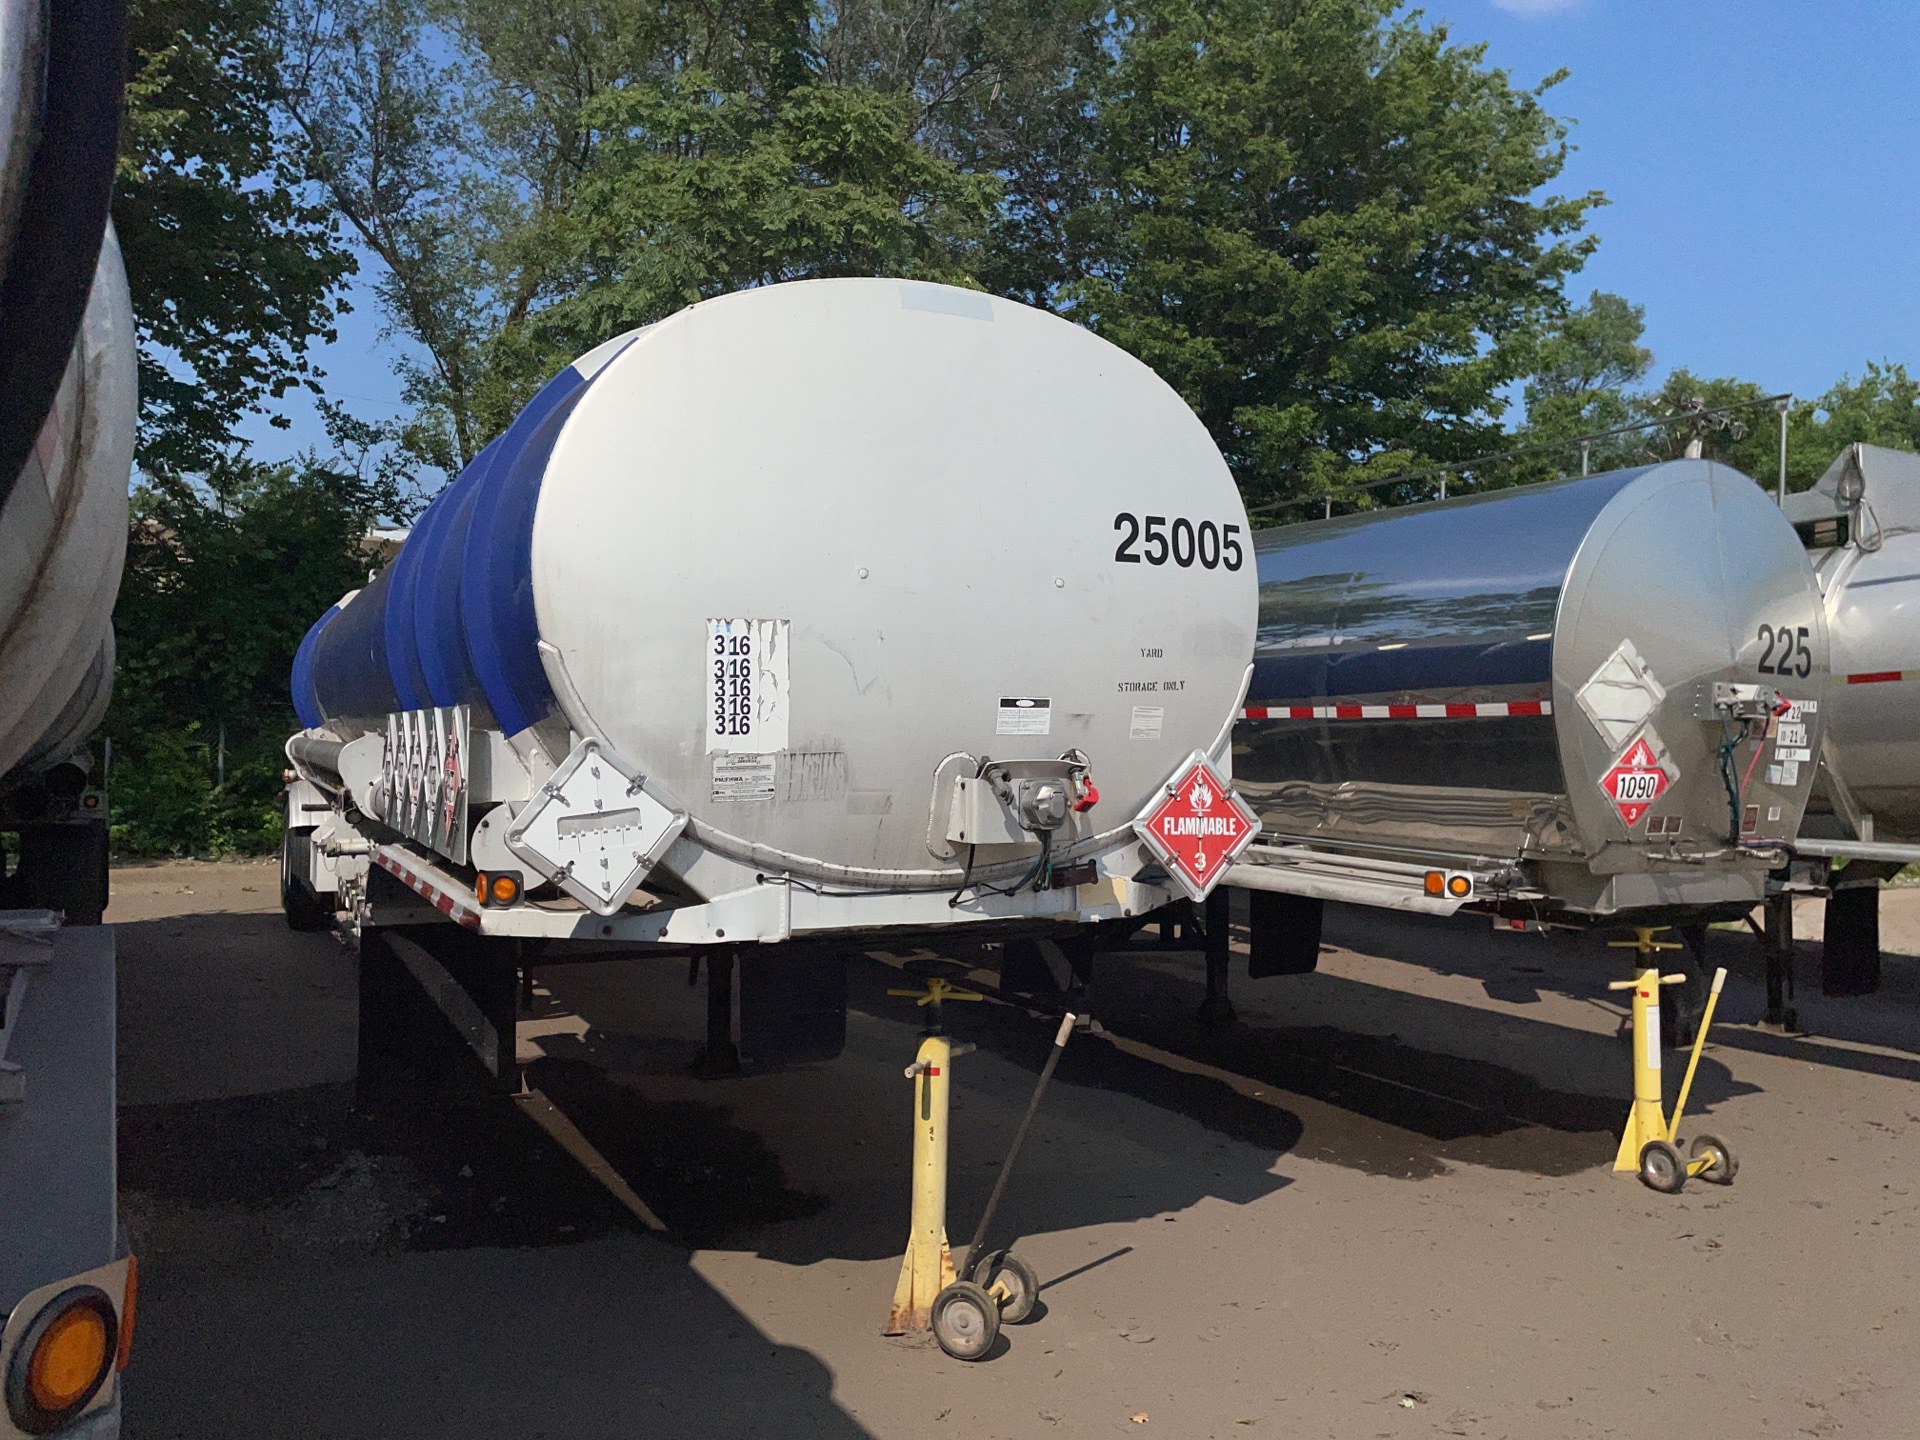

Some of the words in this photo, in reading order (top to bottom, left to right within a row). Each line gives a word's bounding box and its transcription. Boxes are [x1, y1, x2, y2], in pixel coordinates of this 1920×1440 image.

[1114, 512, 1243, 571] 25005
[714, 634, 751, 656] 316
[1140, 648, 1163, 658] YARD
[1758, 623, 1811, 678] 225
[714, 658, 751, 679] 316
[714, 679, 751, 697] 316
[1117, 681, 1158, 692] STORAGE
[1163, 680, 1186, 691] ONLY
[714, 696, 751, 716] 316
[714, 715, 751, 735] 316
[1619, 776, 1656, 799] 1090
[1629, 807, 1637, 820] 3
[1163, 816, 1237, 836] FLAMMABLE
[1193, 852, 1207, 870] 3
